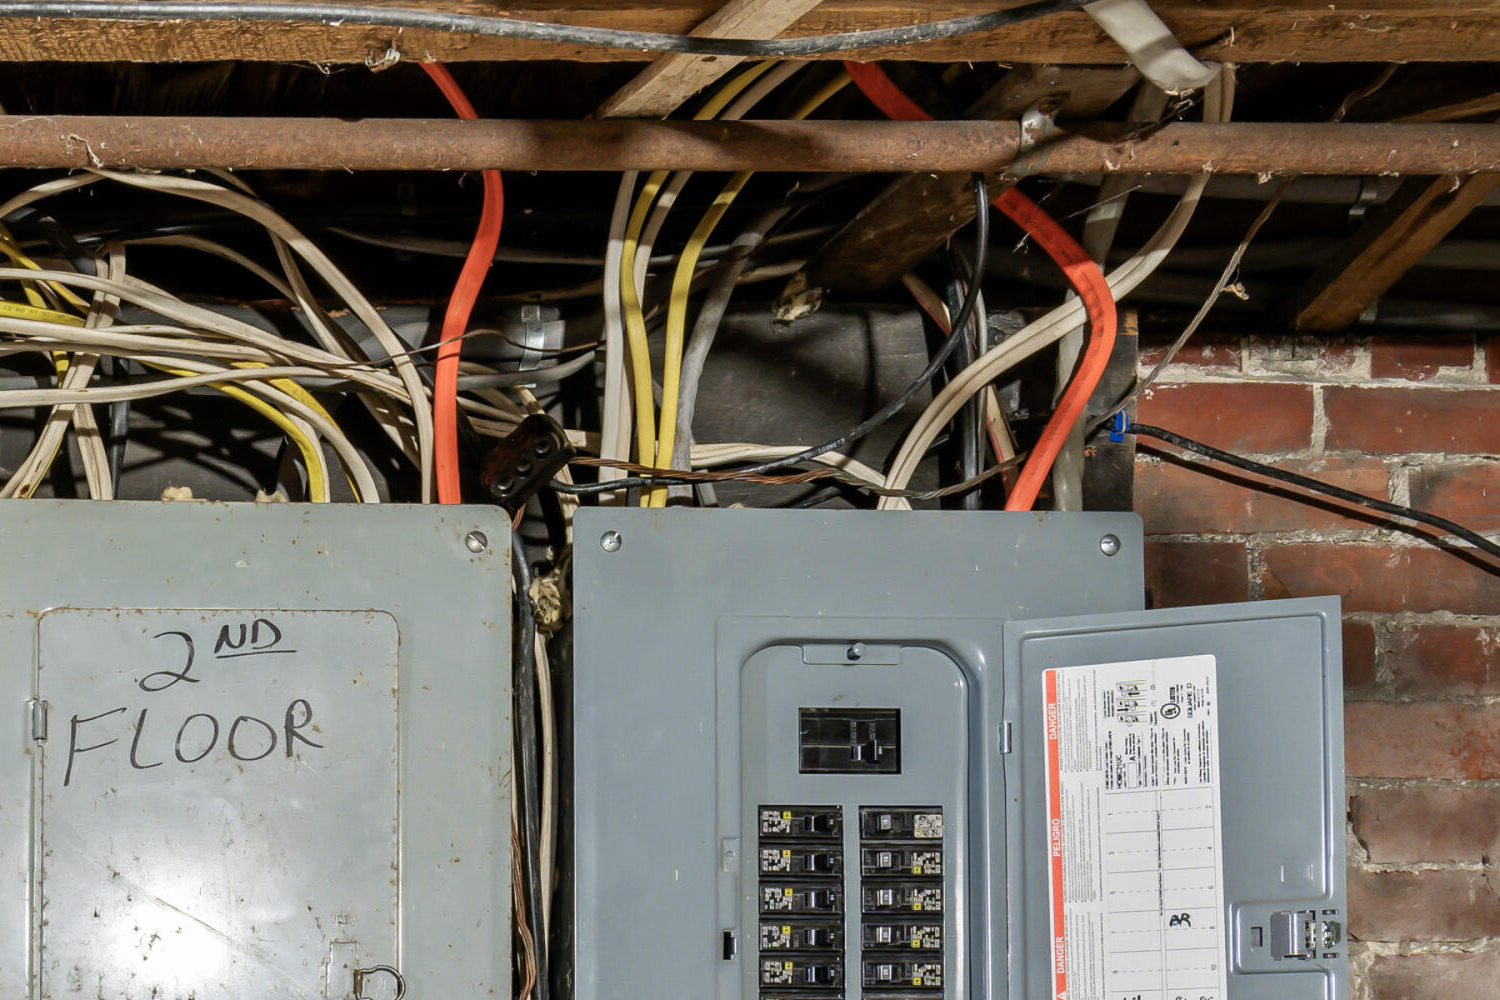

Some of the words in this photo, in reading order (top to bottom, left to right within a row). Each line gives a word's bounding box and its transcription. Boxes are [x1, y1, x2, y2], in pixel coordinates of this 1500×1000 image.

[1049, 702, 1058, 740] DANGER
[62, 698, 325, 787] FLOOR
[1052, 818, 1061, 857] PELIGRO
[1056, 936, 1066, 974] DANGER
